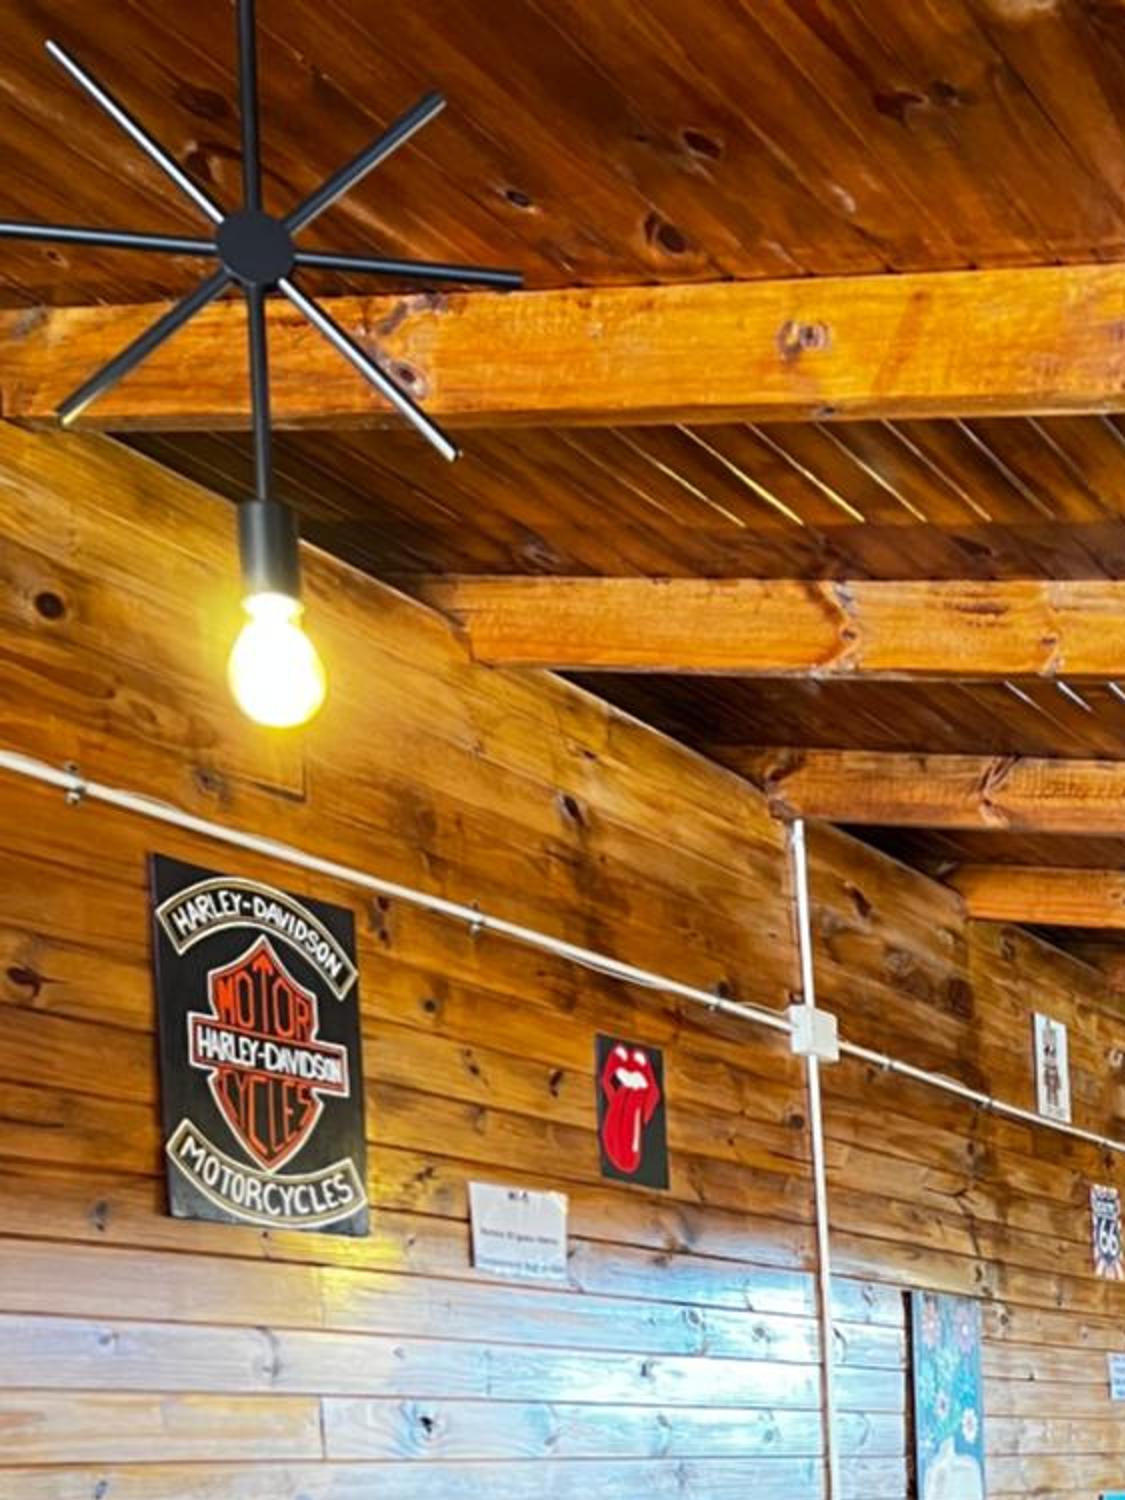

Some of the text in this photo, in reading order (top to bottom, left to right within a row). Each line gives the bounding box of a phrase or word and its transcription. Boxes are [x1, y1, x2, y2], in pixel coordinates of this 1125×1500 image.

[173, 888, 343, 977] HARLEY-DAVIDSON
[217, 952, 311, 1041] MOTOR
[197, 1025, 343, 1083] HARLEY-DAVIDSON
[217, 1070, 314, 1158] CYCLES
[179, 1135, 355, 1216] MOTORCYCLES
